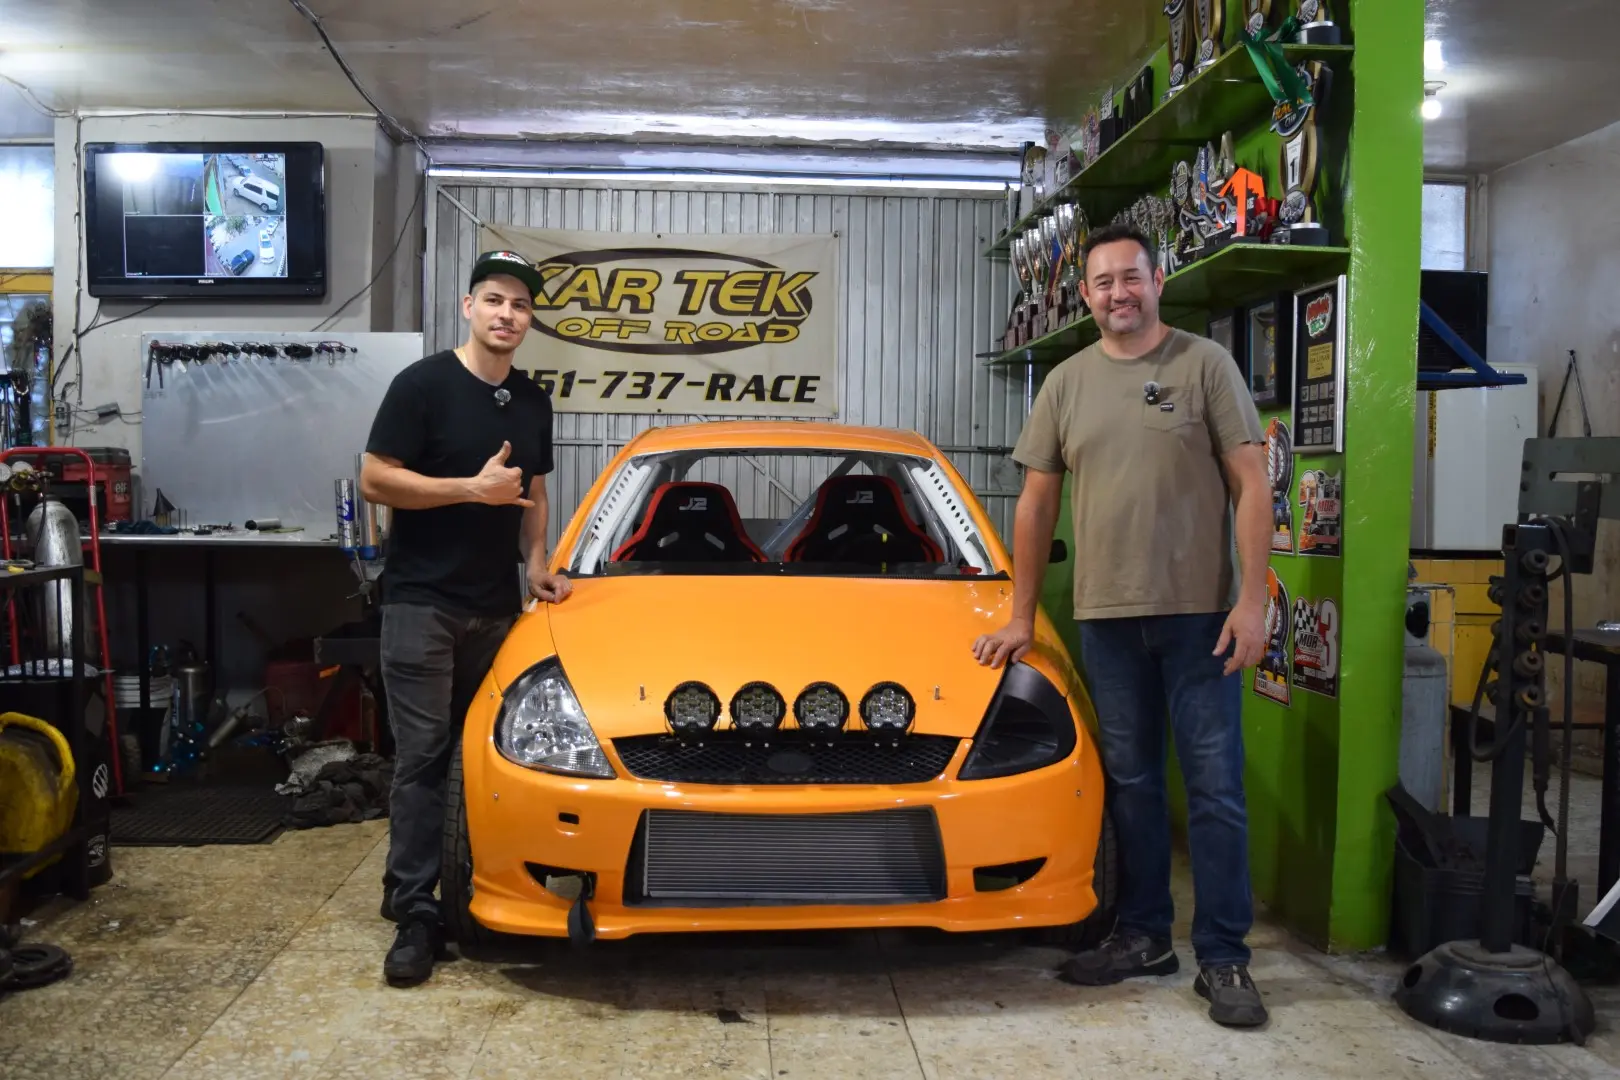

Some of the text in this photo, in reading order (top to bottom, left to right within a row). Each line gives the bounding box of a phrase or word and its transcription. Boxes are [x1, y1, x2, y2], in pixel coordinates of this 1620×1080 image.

[533, 264, 819, 319] KAR TEK
[555, 317, 801, 345] OFF ROAD
[519, 369, 821, 404] 51-737-RACE
